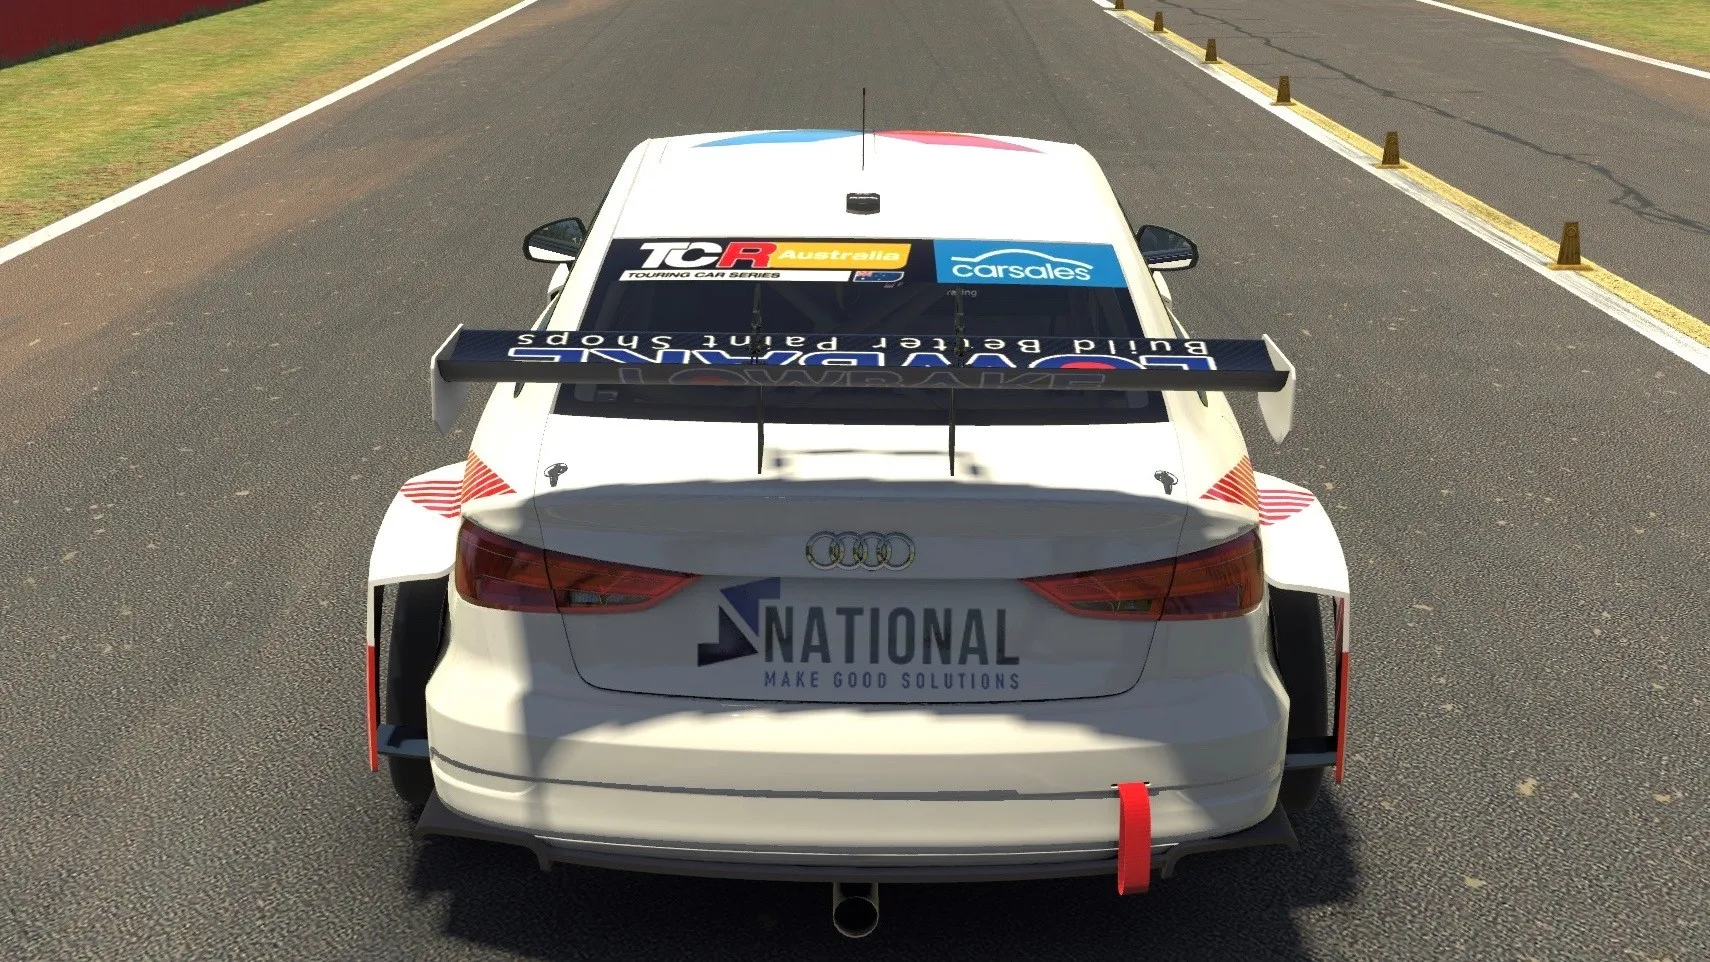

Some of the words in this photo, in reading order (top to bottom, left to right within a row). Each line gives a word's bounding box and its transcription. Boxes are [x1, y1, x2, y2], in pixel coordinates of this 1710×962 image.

[639, 241, 779, 269] TCR
[777, 249, 900, 262] Australia
[627, 271, 690, 279] TOURING
[951, 262, 1091, 281] carsales
[946, 288, 978, 298] raing
[516, 332, 673, 350] Shops
[702, 334, 838, 351] Paint
[1073, 338, 1209, 355] Build
[764, 605, 1020, 665] NATIONAL
[764, 670, 819, 688] MAKE
[833, 671, 888, 688] GOOD
[901, 672, 1020, 690] SOLUTIONS
